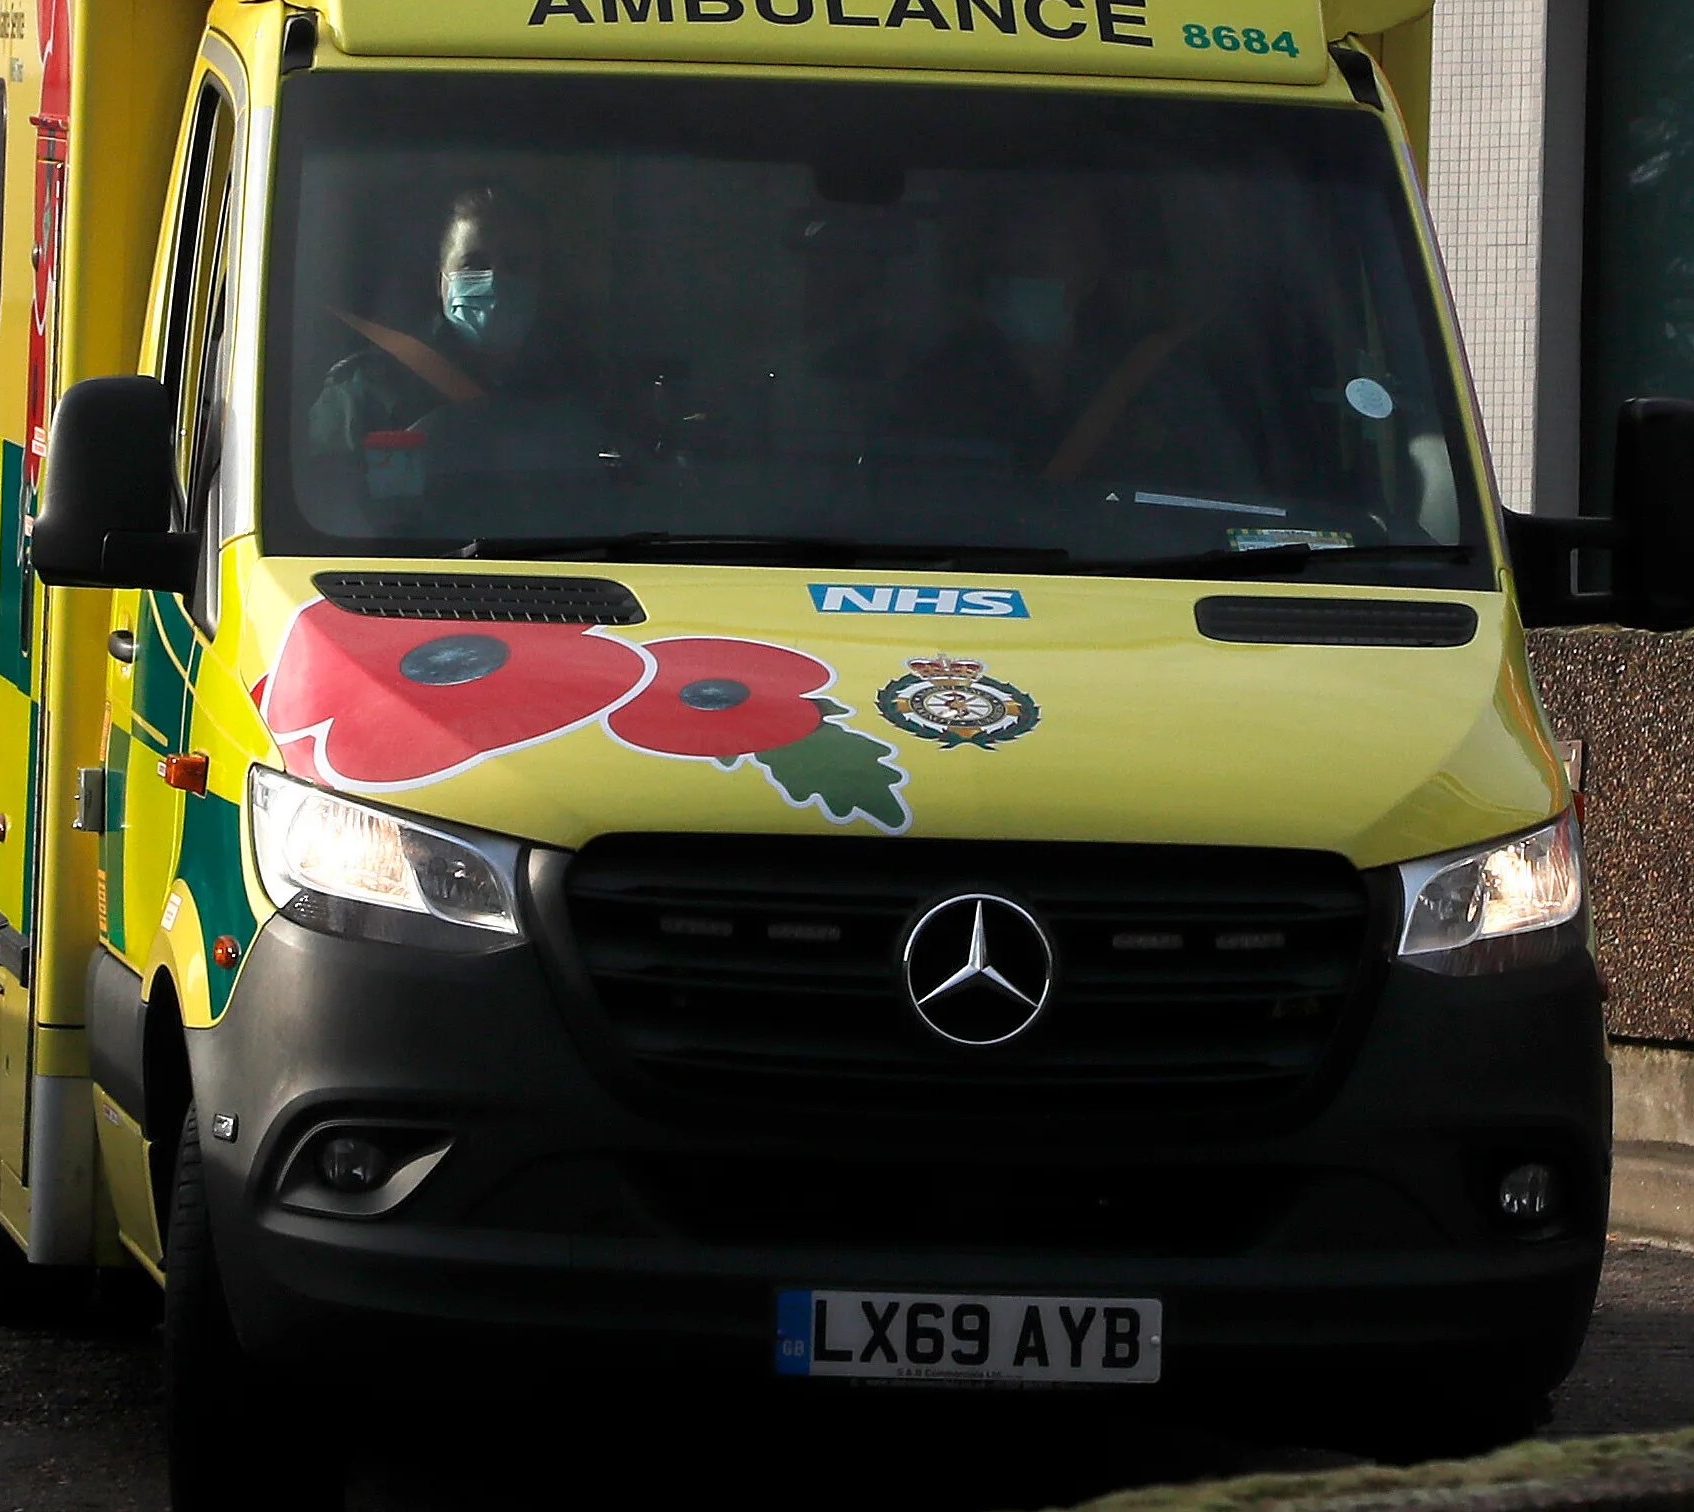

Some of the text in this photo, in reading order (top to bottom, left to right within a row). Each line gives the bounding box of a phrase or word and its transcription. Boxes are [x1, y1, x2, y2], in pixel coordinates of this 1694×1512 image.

[1182, 23, 1300, 58] 8684
[822, 586, 1013, 615] NHS
[782, 1339, 805, 1357] GB
[813, 1299, 1140, 1369] LX69 AYB
